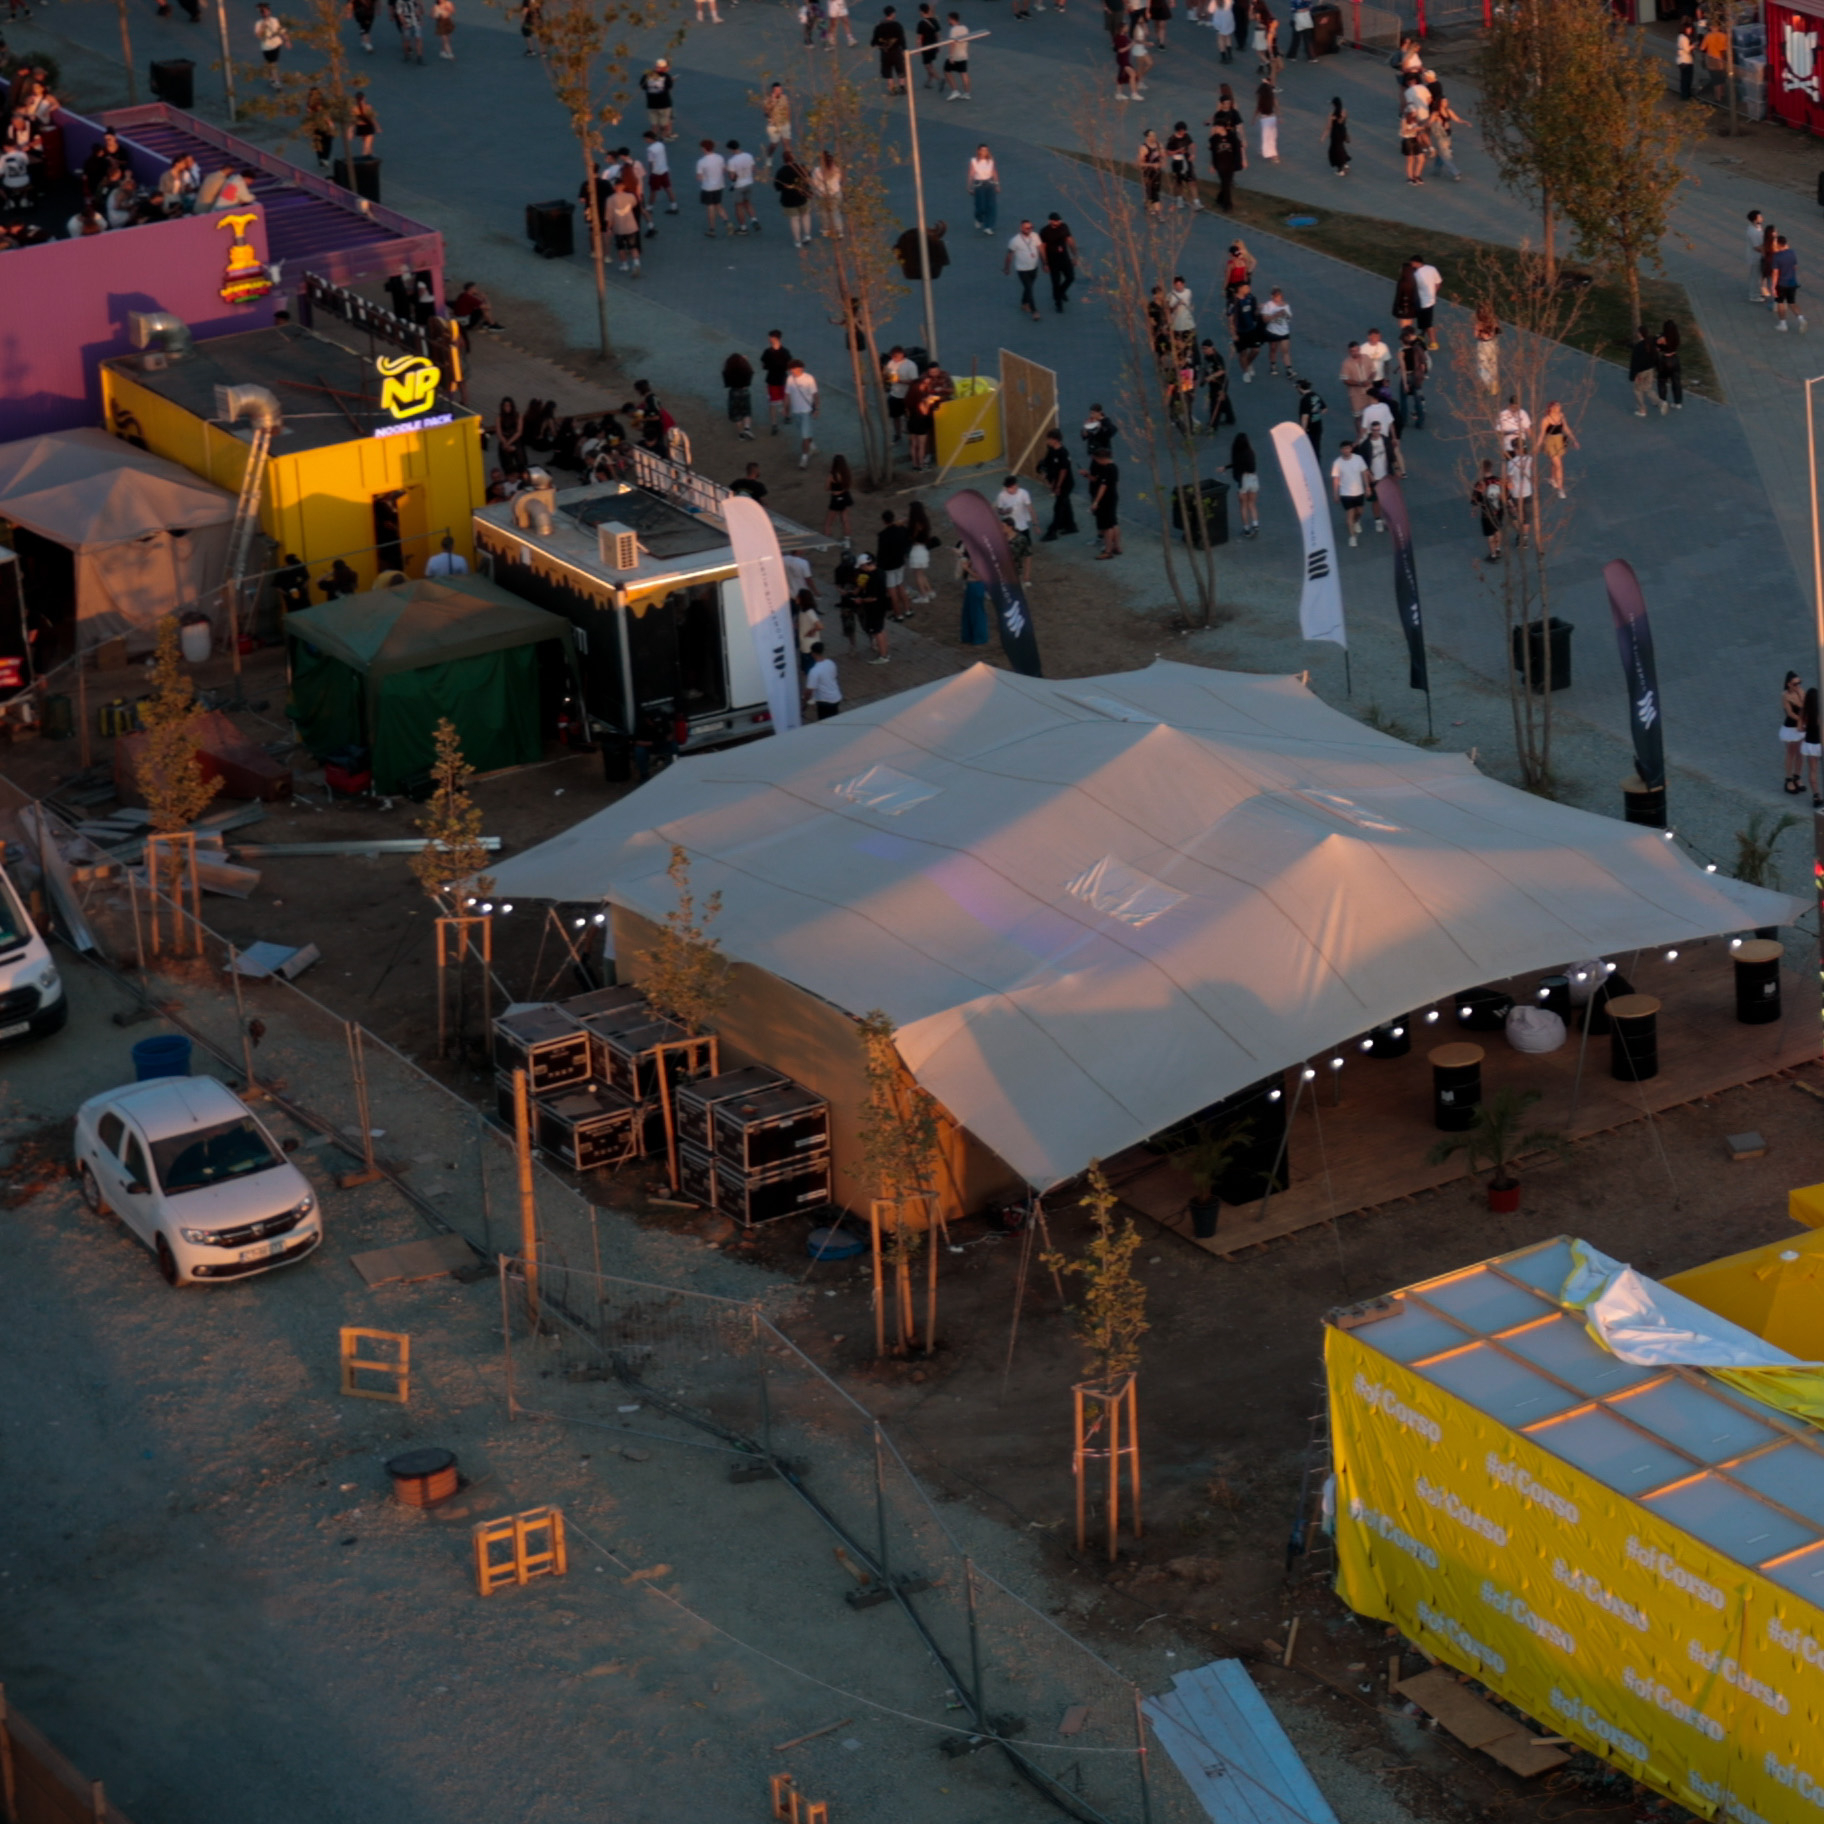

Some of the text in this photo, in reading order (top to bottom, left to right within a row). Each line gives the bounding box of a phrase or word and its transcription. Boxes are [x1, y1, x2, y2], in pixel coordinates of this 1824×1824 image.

[381, 366, 441, 409] NP
[373, 412, 454, 438] NOODLE PACK
